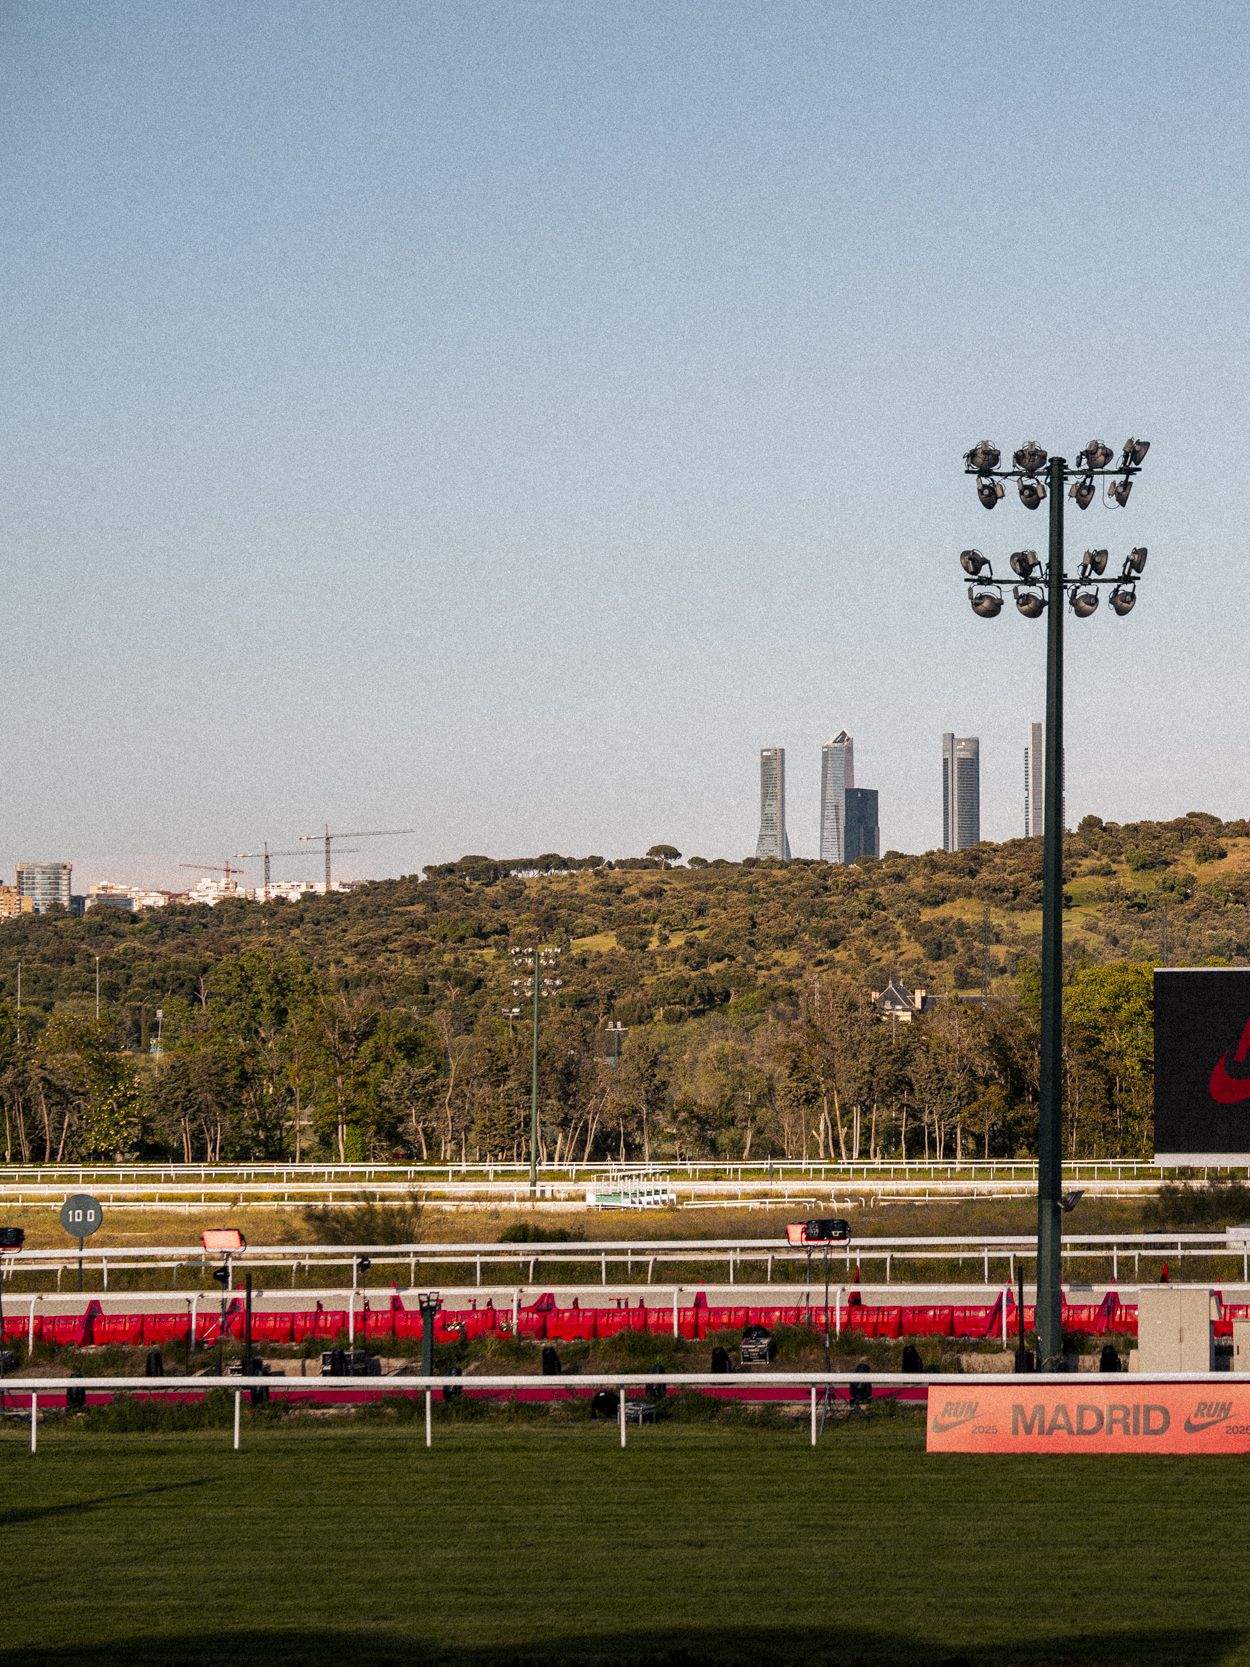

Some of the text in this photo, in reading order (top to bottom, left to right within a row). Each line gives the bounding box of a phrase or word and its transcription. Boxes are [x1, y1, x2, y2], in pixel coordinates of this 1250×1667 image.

[68, 1209, 95, 1222] 100
[941, 1401, 979, 1418] RUN
[1194, 1401, 1233, 1418] RUN
[1011, 1403, 1171, 1436] MADRID
[970, 1425, 998, 1434] 2025
